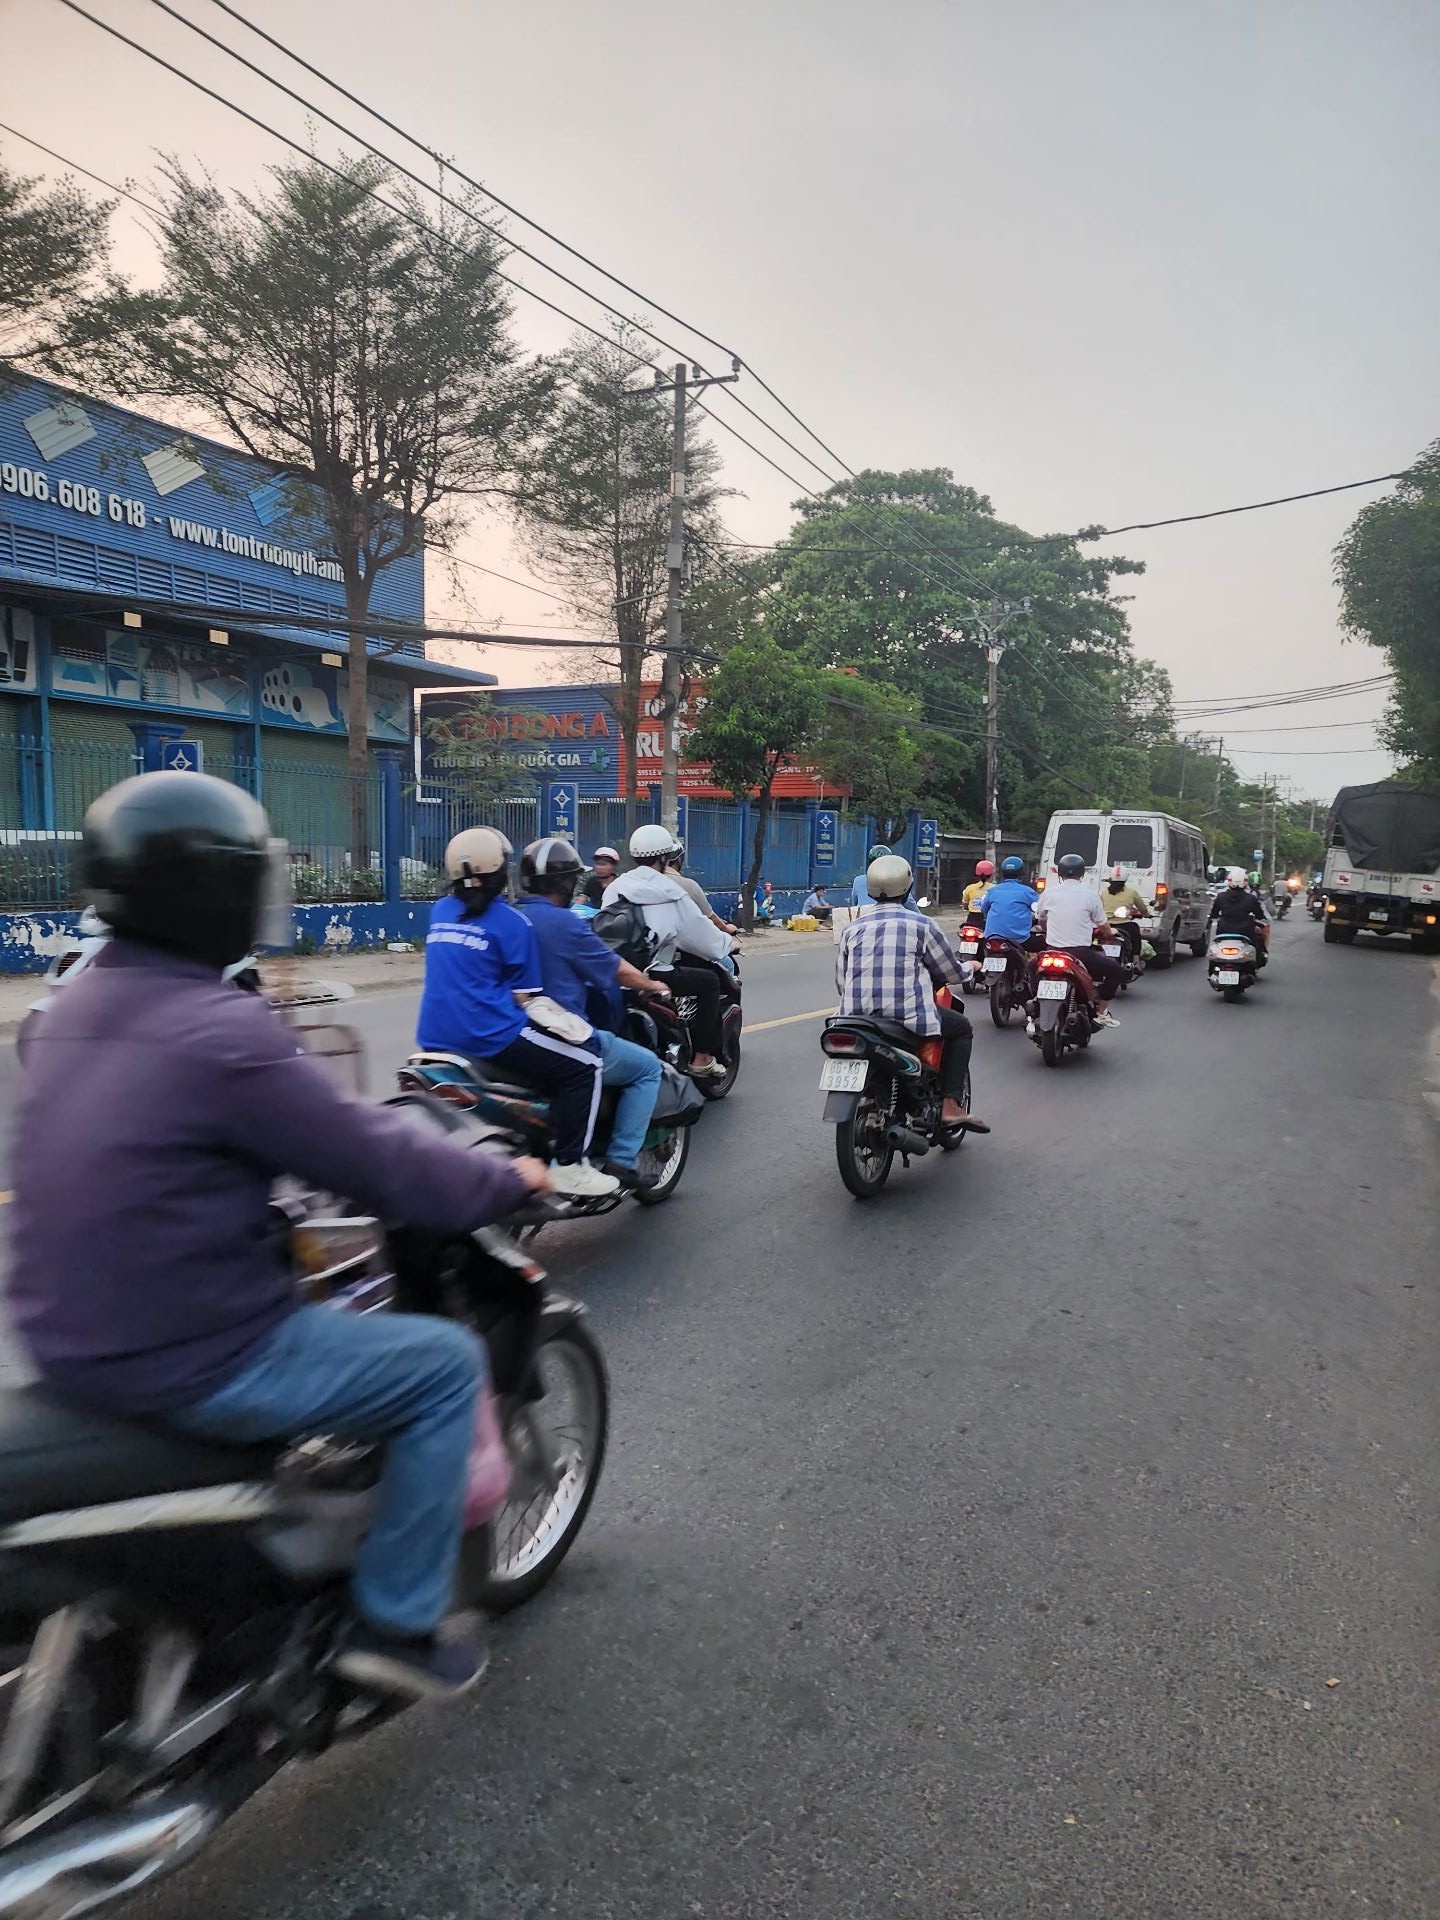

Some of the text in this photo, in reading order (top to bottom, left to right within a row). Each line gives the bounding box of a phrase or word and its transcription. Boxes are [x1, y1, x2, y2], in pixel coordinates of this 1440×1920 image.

[0, 462, 102, 516] 906.608
[108, 493, 146, 528] 618
[557, 753, 582, 767] GIA
